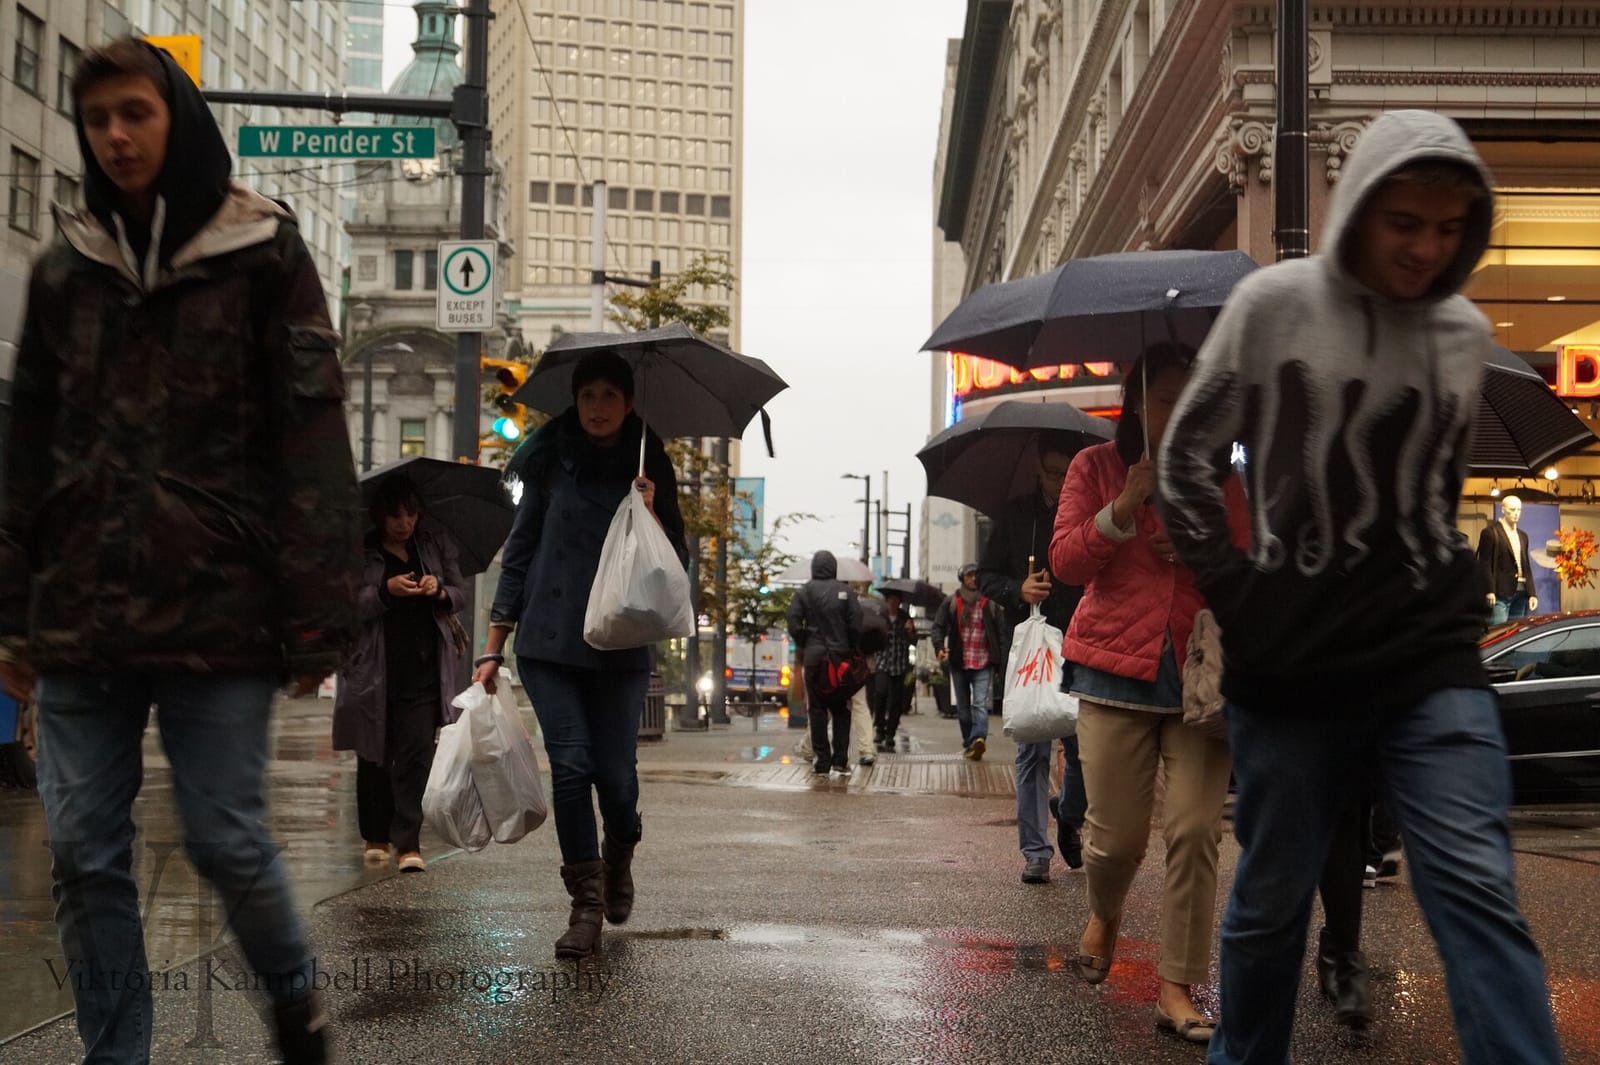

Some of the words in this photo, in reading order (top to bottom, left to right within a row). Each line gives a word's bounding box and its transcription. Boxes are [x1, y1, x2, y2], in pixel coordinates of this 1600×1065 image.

[258, 130, 281, 153] W
[292, 130, 382, 154] Pender
[391, 130, 415, 154] St
[446, 300, 486, 312] EXCEPT
[447, 312, 484, 325] BUSES
